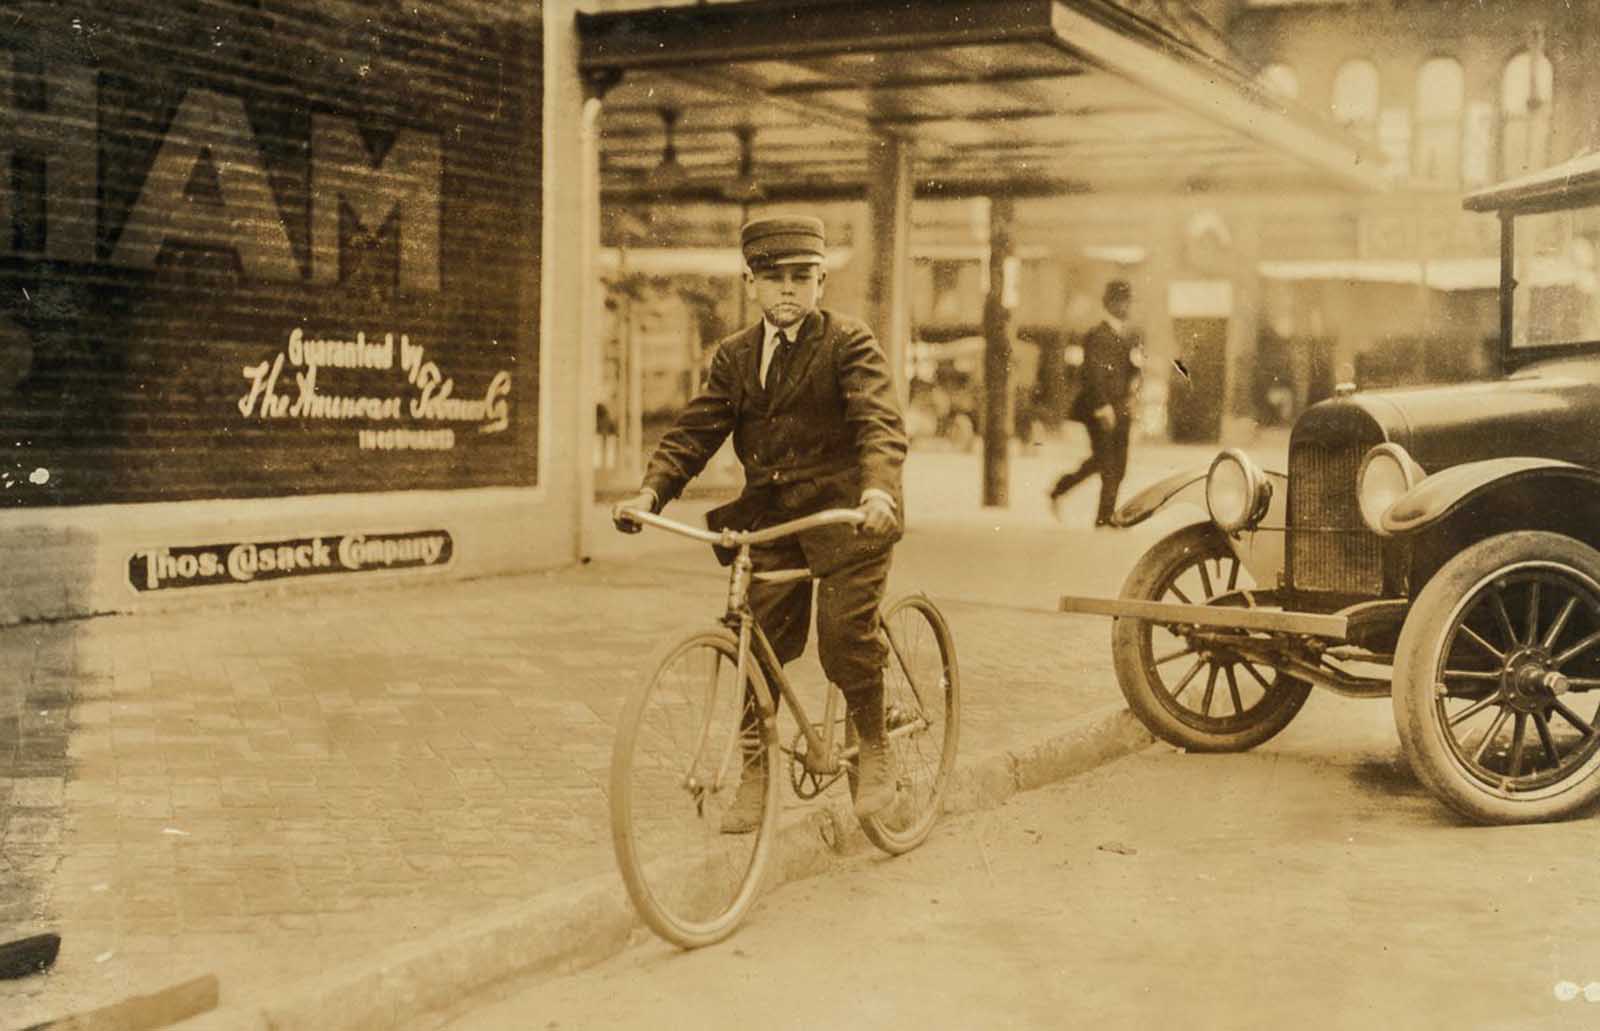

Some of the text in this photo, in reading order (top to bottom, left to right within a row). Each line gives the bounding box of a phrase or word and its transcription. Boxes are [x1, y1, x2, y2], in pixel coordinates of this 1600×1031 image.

[239, 353, 290, 418] The
[401, 334, 424, 384] by
[134, 534, 446, 589] Thos. Cusack Company
